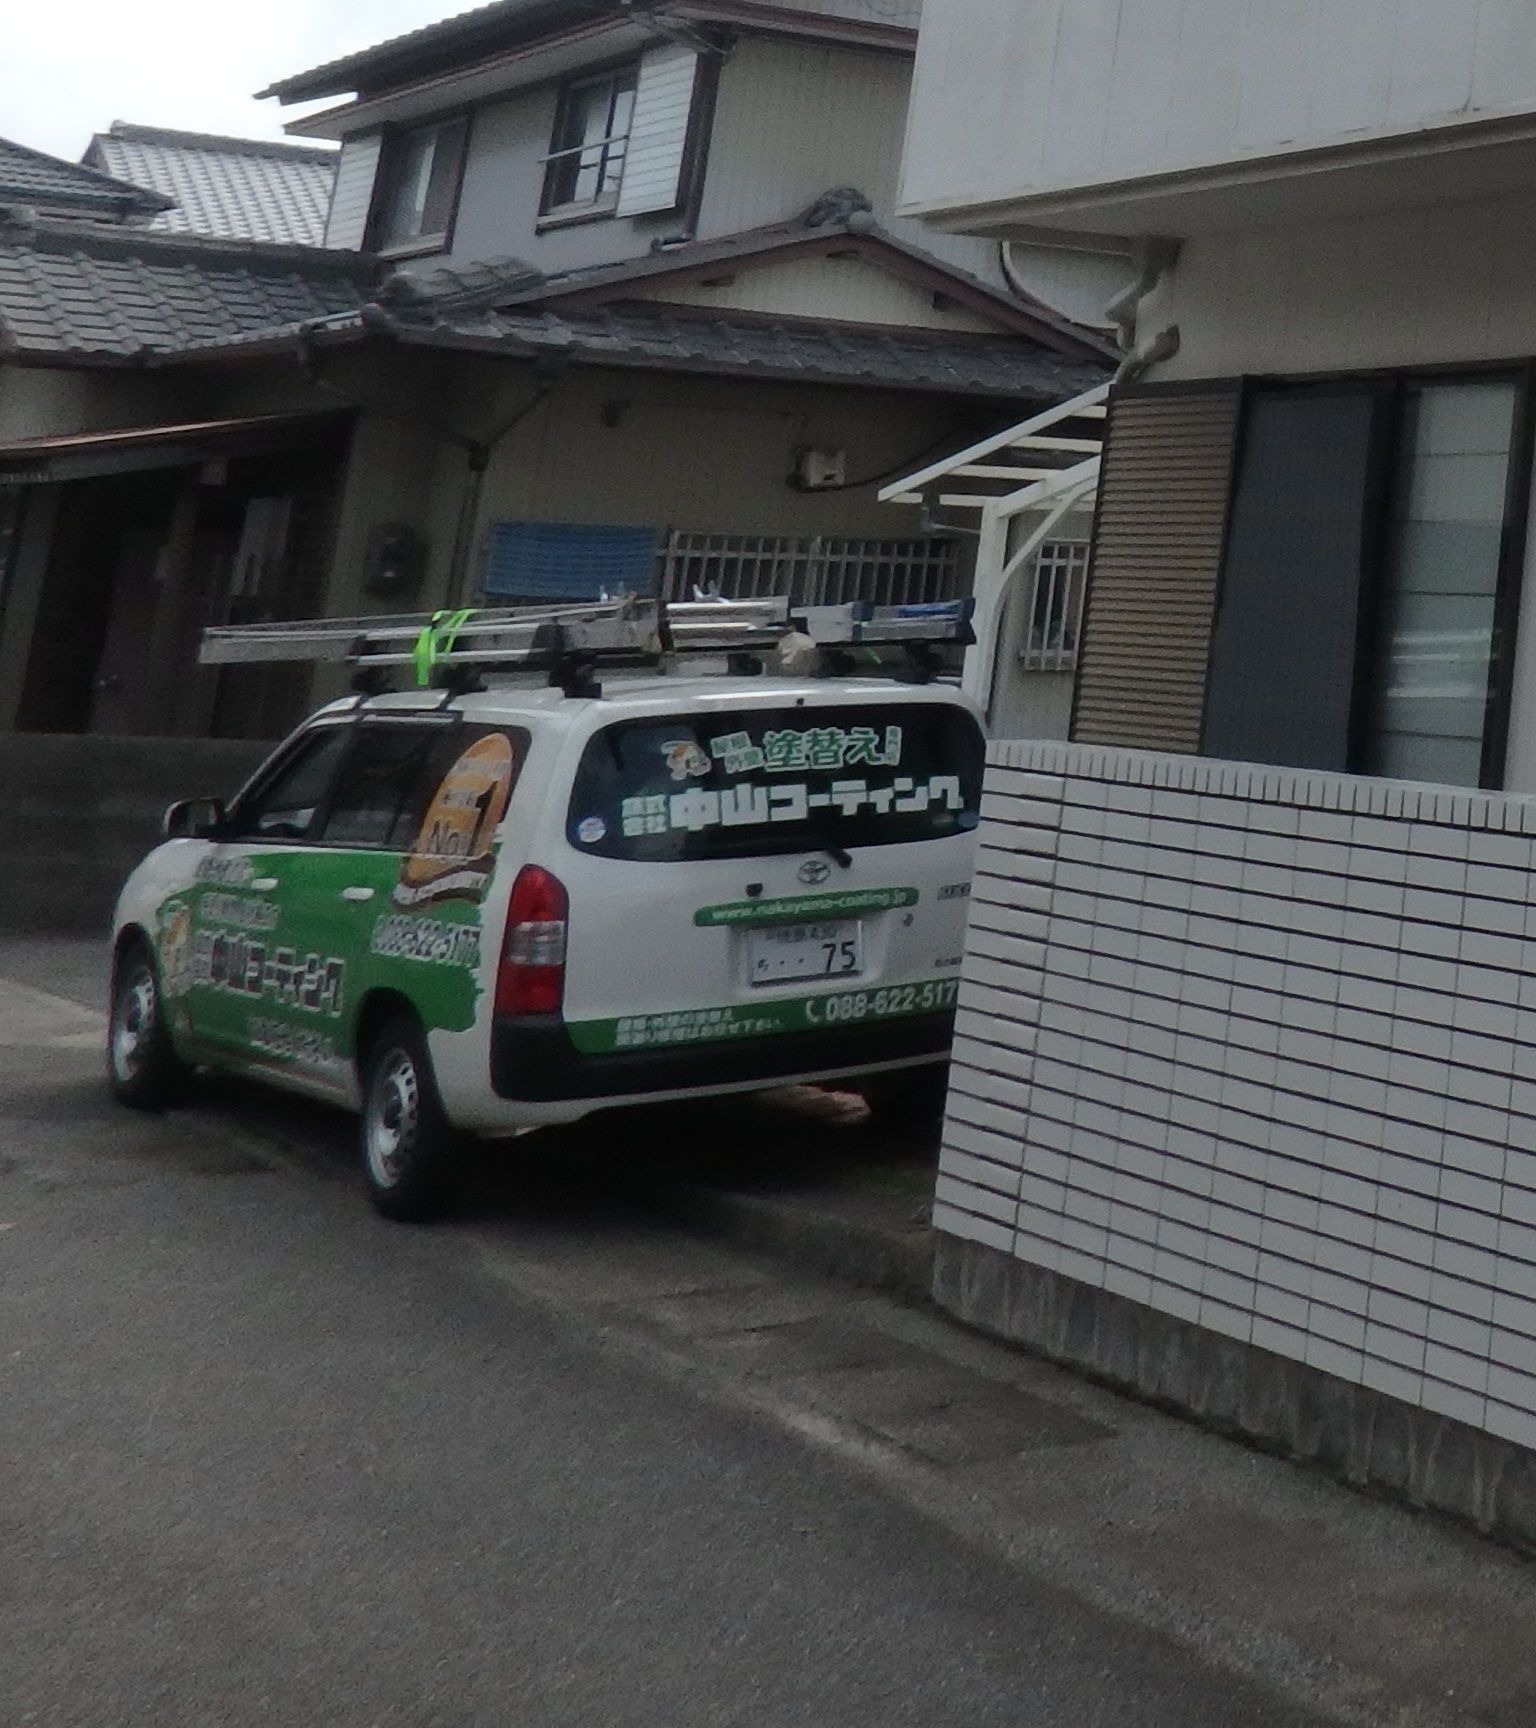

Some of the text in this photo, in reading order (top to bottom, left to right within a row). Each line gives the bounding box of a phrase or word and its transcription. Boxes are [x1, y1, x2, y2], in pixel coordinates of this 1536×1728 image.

[763, 727, 885, 772] 塗替え
[669, 776, 964, 830] 中山コーティング
[821, 940, 857, 972] 75
